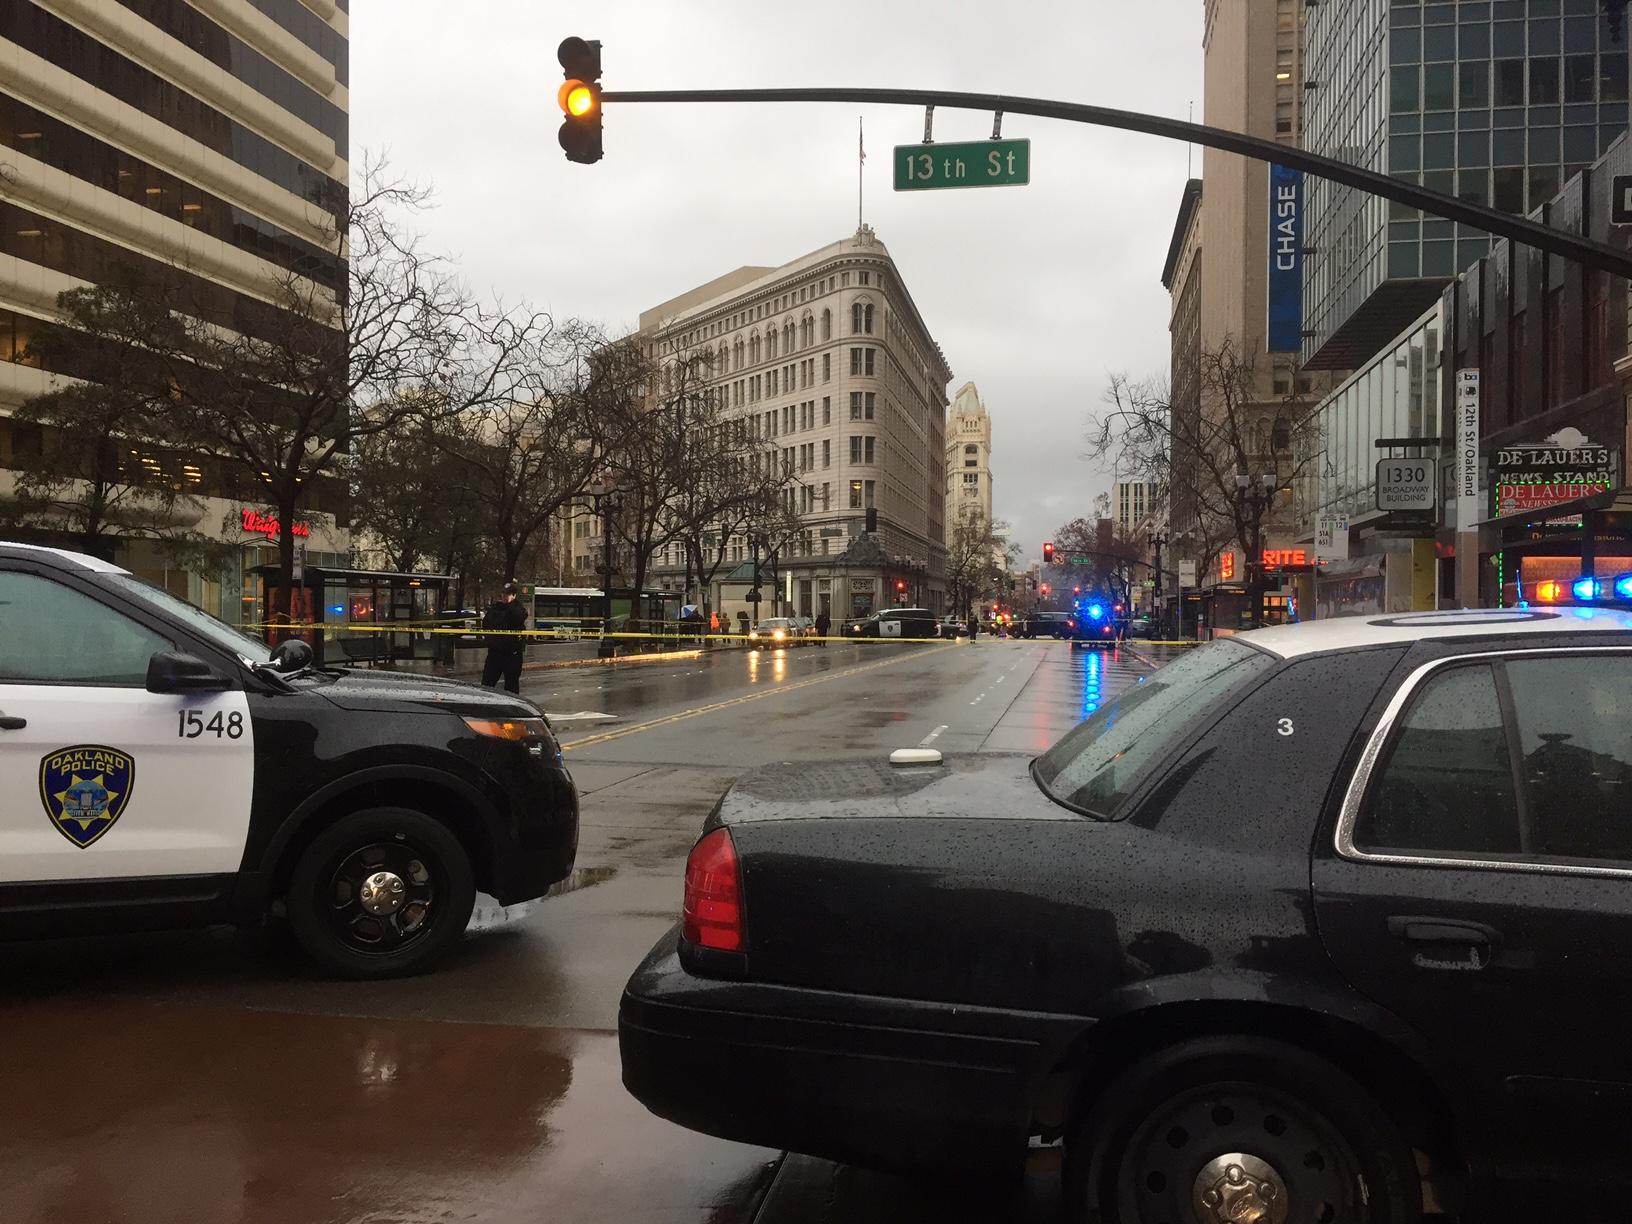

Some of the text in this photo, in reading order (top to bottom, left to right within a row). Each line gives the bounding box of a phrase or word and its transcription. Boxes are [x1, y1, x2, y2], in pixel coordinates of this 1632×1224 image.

[987, 150, 1016, 177] St
[1277, 184, 1296, 271] CHASE
[1465, 402, 1476, 497] 12th St/Oakland
[1498, 451, 1523, 465] DE
[1386, 467, 1425, 483] 1330
[1501, 470, 1610, 482] NEWS STAND
[1382, 485, 1430, 494] BROADWAY
[1502, 485, 1525, 499] DE
[1386, 494, 1427, 502] BUILDING
[1263, 549, 1305, 565] RITE
[178, 709, 244, 740] 1548
[1277, 718, 1294, 736] 3
[52, 751, 124, 769] OAKLAND
[61, 760, 115, 776] POLICE
